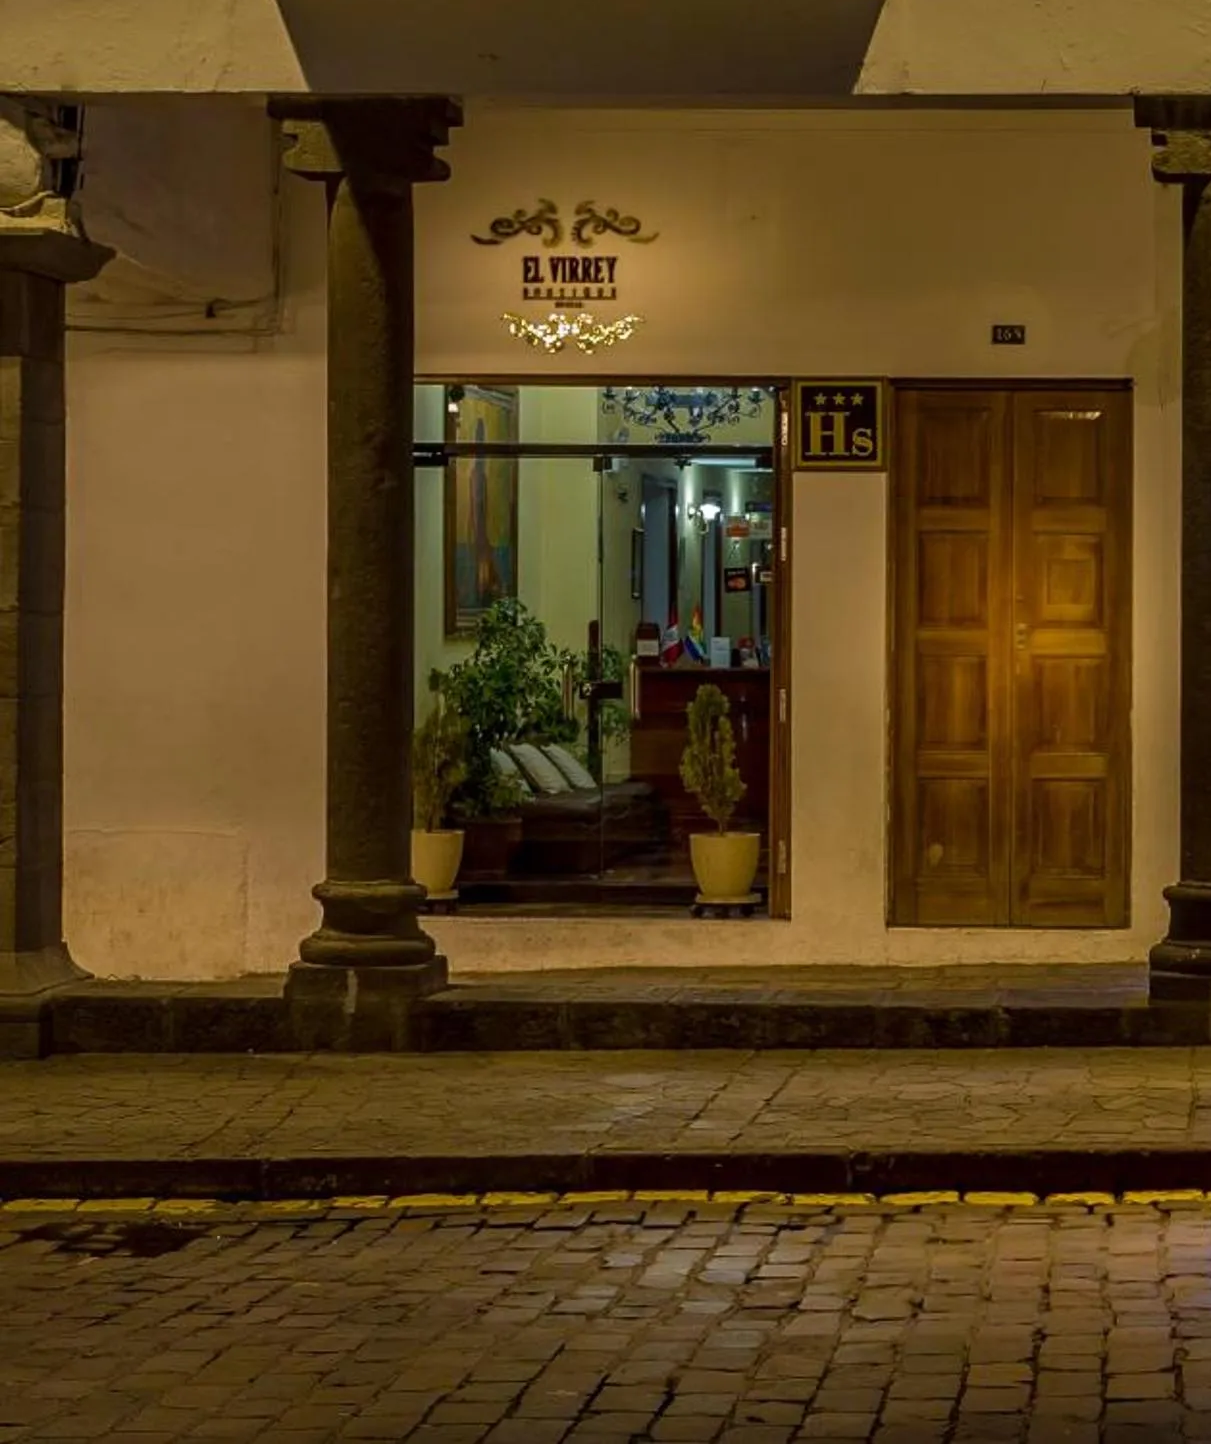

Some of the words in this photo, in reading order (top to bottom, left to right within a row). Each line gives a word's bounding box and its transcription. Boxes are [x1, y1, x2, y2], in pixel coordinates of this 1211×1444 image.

[523, 256, 545, 283] EL
[549, 256, 617, 283] VIRREY
[804, 411, 874, 456] Hs
